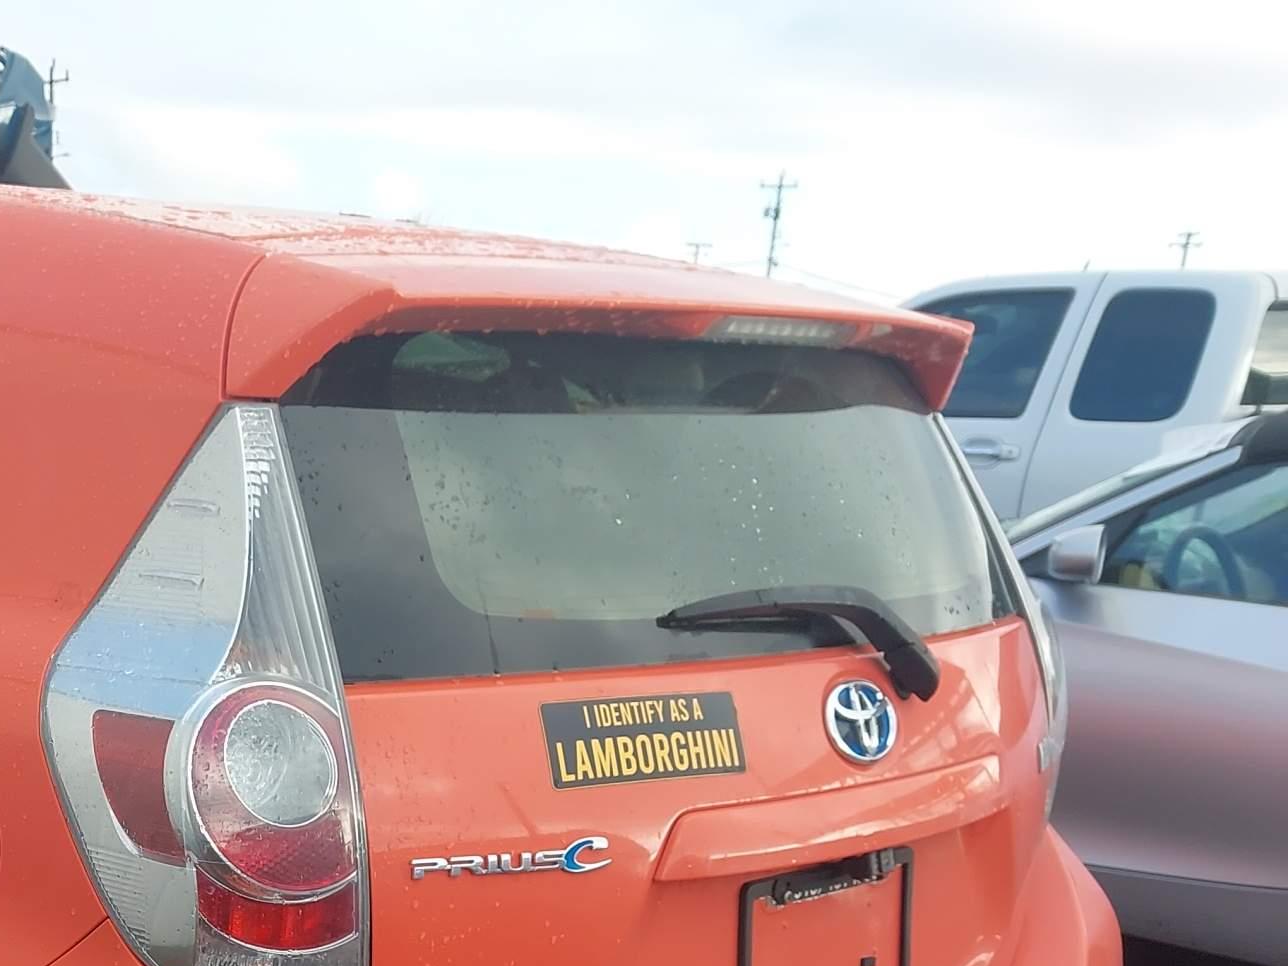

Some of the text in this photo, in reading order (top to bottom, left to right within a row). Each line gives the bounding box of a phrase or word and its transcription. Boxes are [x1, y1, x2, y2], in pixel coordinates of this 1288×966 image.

[583, 697, 704, 729] I IDENTIFY AS A
[555, 728, 740, 783] LAMBORGHINI
